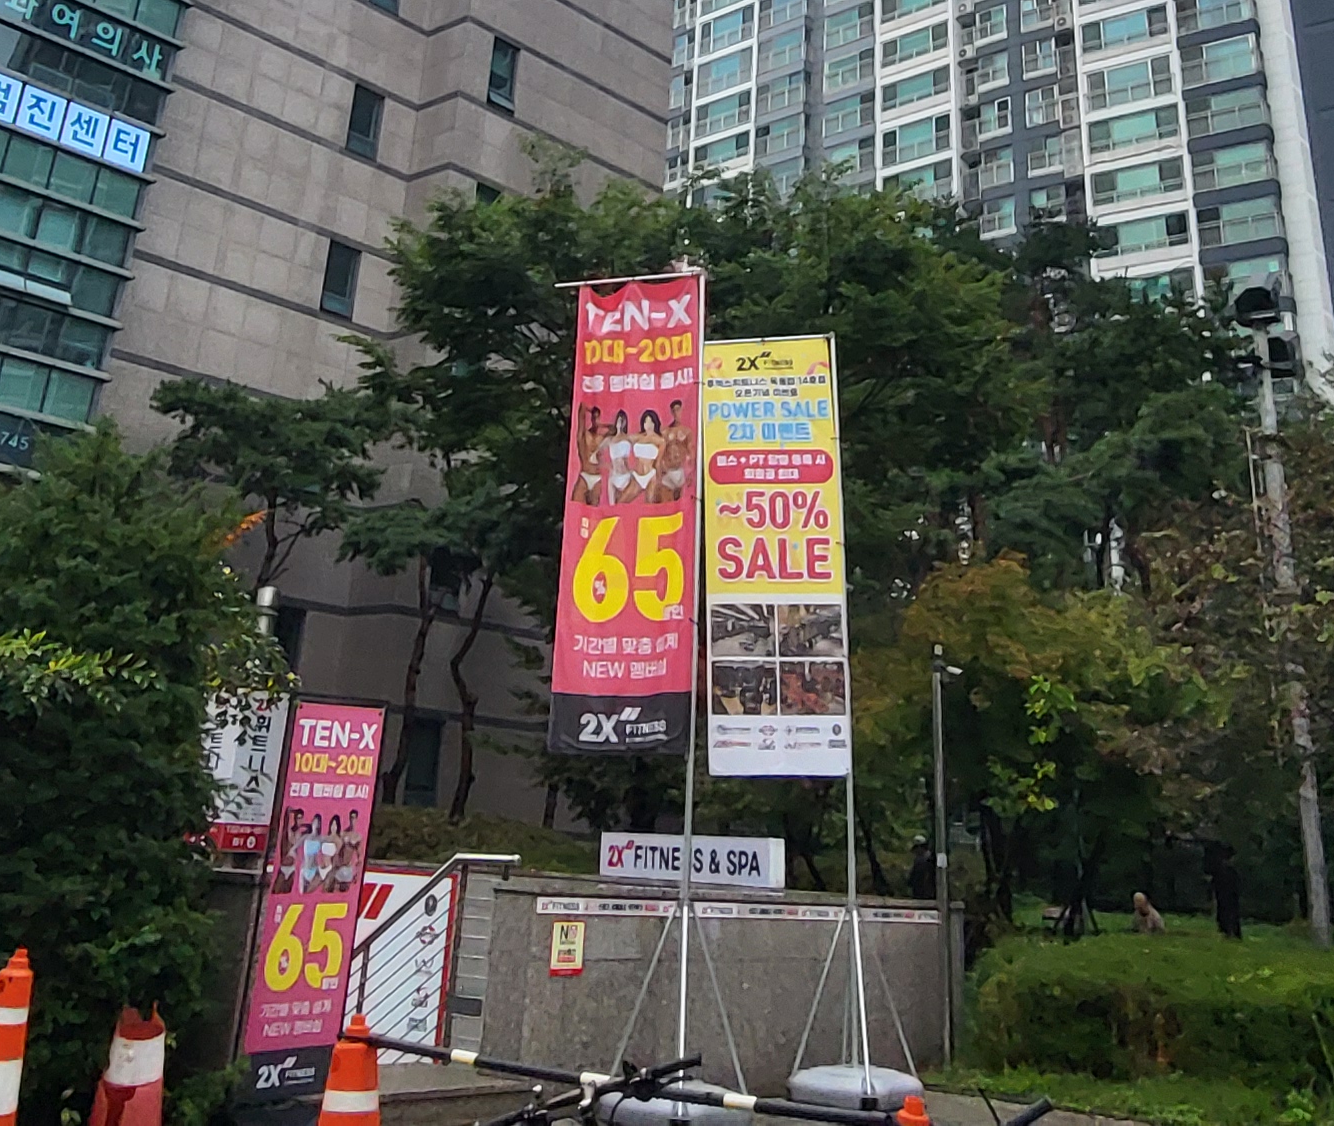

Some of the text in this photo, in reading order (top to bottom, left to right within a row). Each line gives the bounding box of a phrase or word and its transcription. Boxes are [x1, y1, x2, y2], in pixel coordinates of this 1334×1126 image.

[51, 2, 164, 80] 여의사
[585, 294, 693, 334] TEN-X
[735, 356, 761, 372] 2X
[708, 399, 830, 421] POWER SALE
[727, 421, 756, 441] 2차
[573, 512, 685, 623] 65
[717, 537, 833, 580] SALE
[582, 659, 626, 679] NEW
[299, 718, 379, 751] TEN-X
[578, 712, 620, 744] 2X
[607, 844, 762, 877] 2X FITNES & SPA
[264, 903, 349, 992] 65
[255, 1064, 284, 1090] 2X
